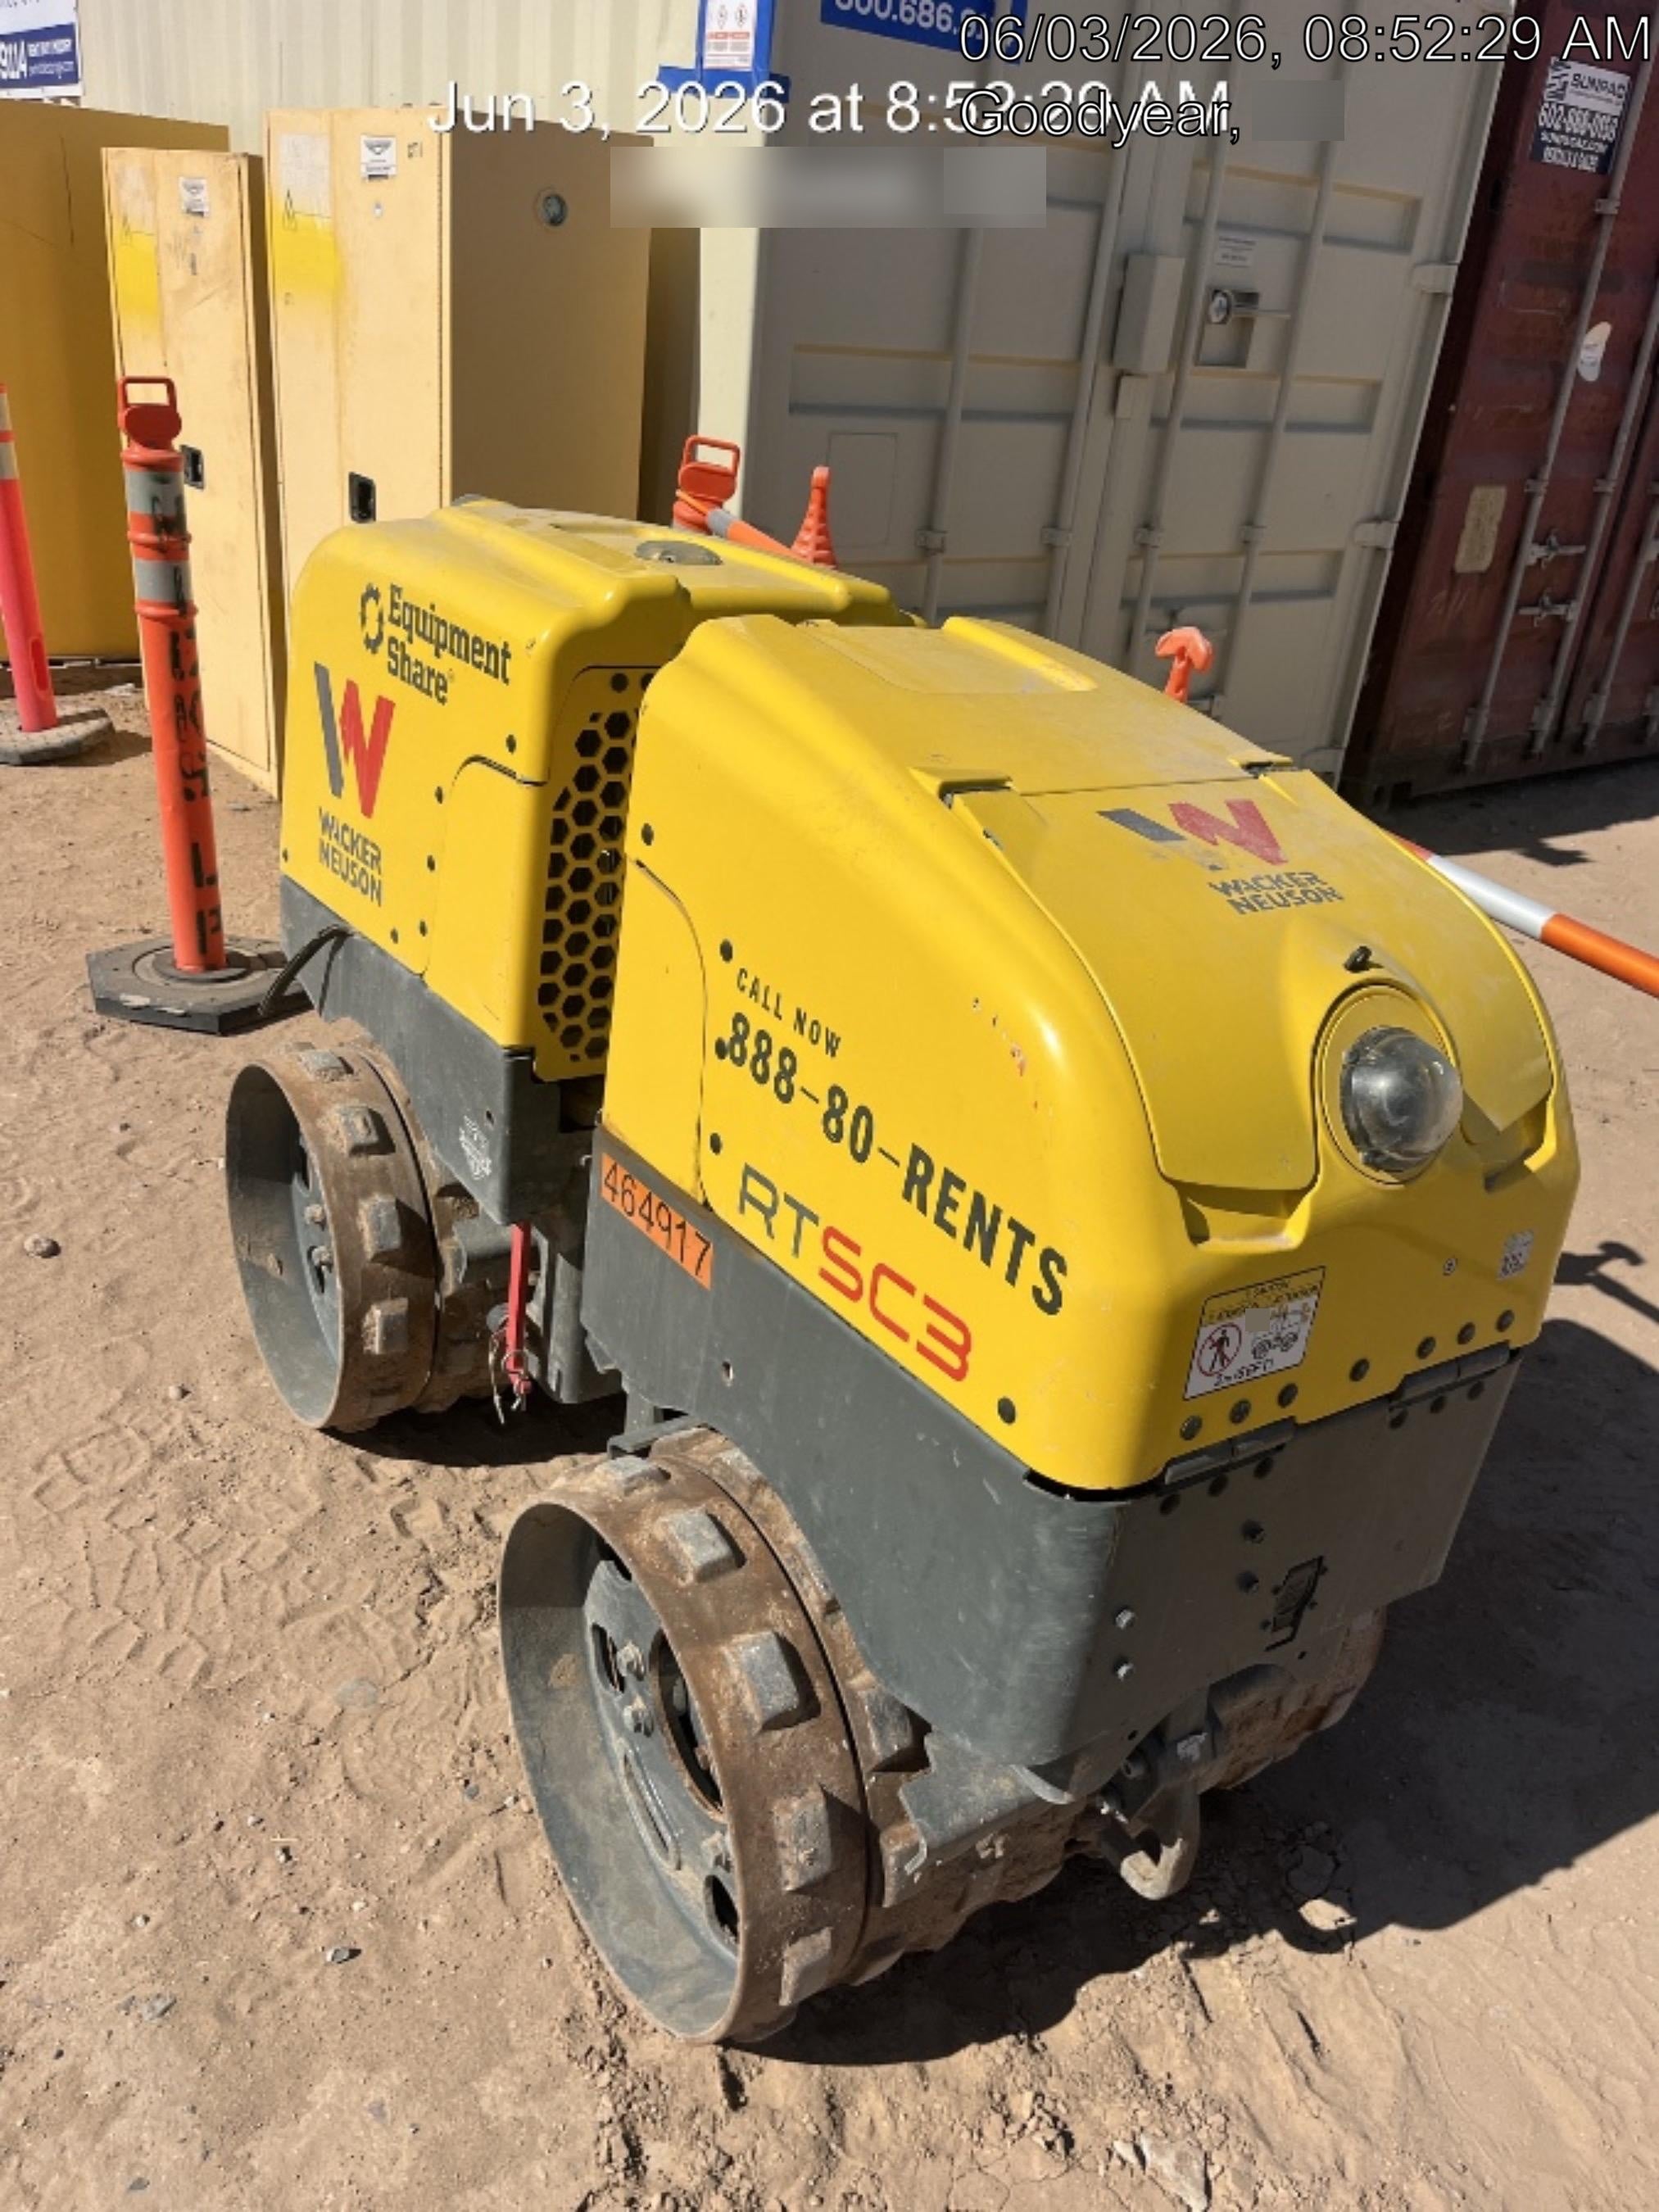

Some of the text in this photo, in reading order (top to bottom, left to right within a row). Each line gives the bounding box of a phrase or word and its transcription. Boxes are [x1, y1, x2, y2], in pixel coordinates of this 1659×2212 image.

[388, 582, 512, 686] Equipment
[318, 837, 382, 908] NEUSON
[319, 806, 382, 876] WACKER
[1207, 872, 1328, 896] WACKER
[1227, 886, 1345, 915] NEUSON
[737, 968, 842, 1058] CALL NOW
[728, 1012, 1068, 1317] 888-80-RENTS
[604, 1162, 712, 1280] 464917
